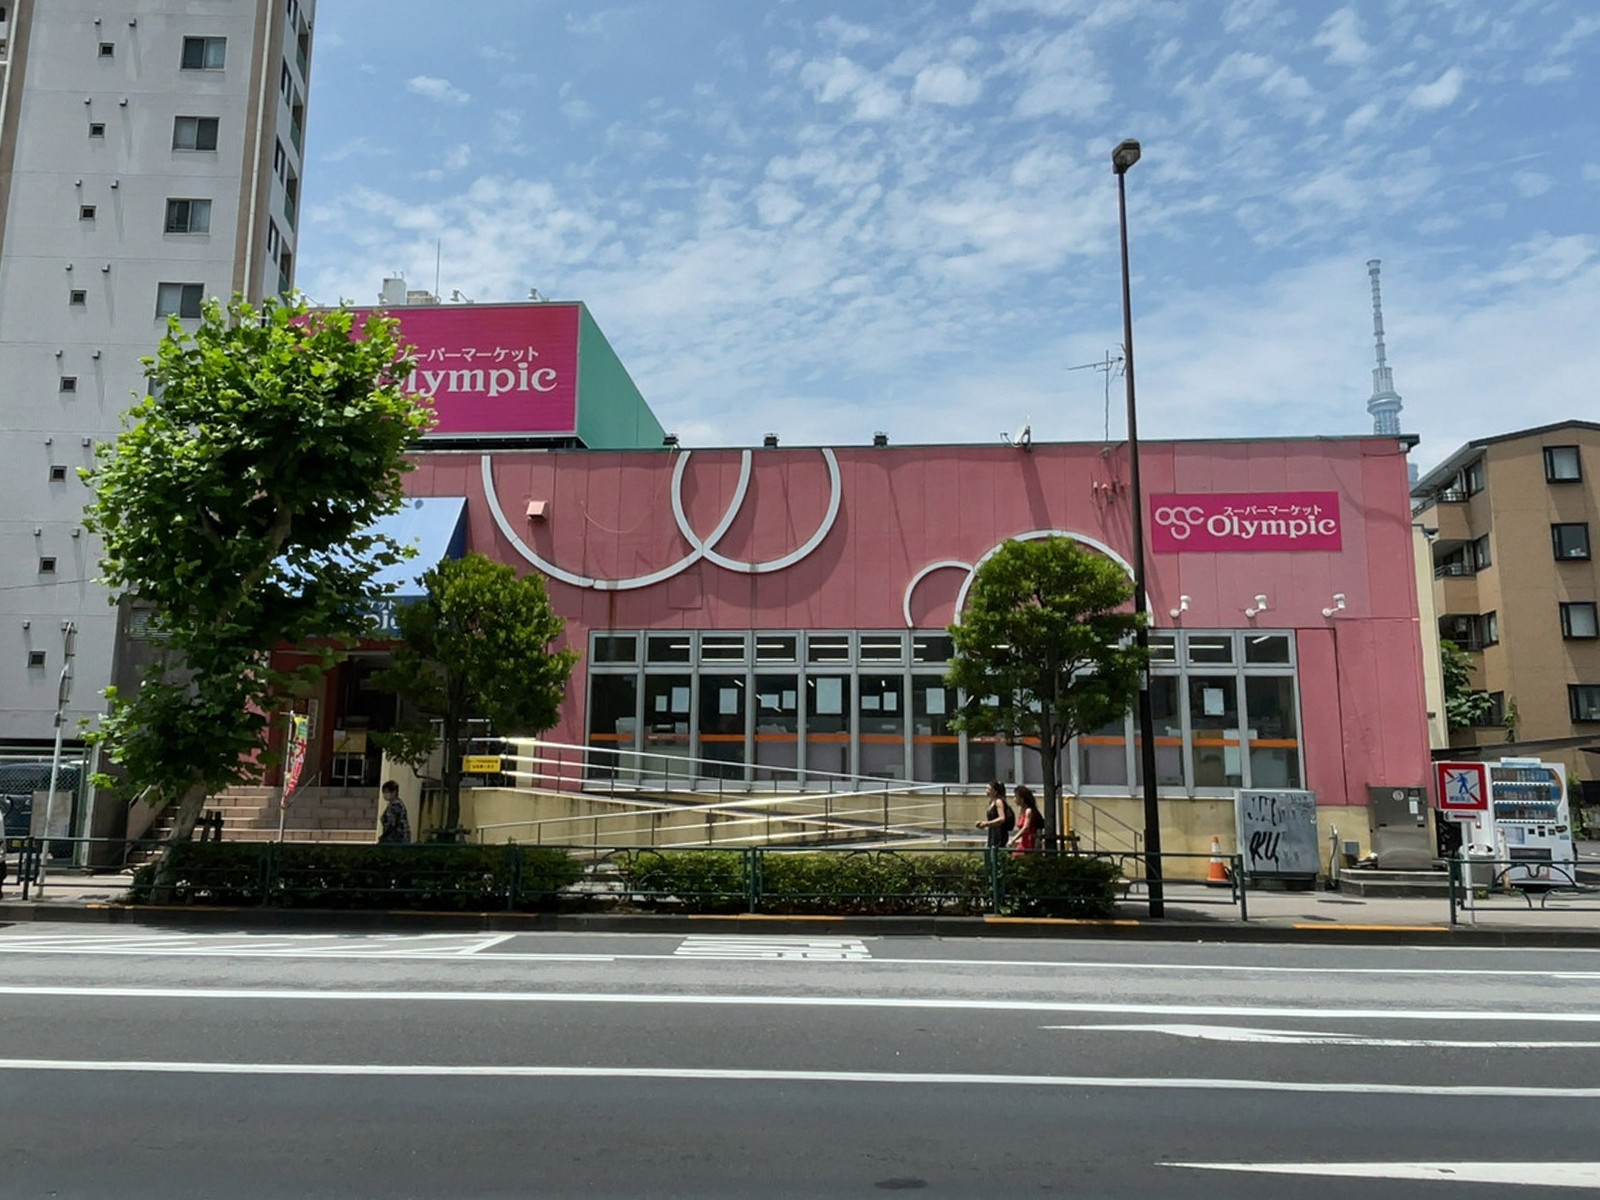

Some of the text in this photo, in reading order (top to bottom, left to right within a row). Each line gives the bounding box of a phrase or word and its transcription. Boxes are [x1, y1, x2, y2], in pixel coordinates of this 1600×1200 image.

[404, 362, 558, 397] lympic
[1223, 504, 1322, 516] スーパーマーケット
[1207, 514, 1337, 539] Olympic
